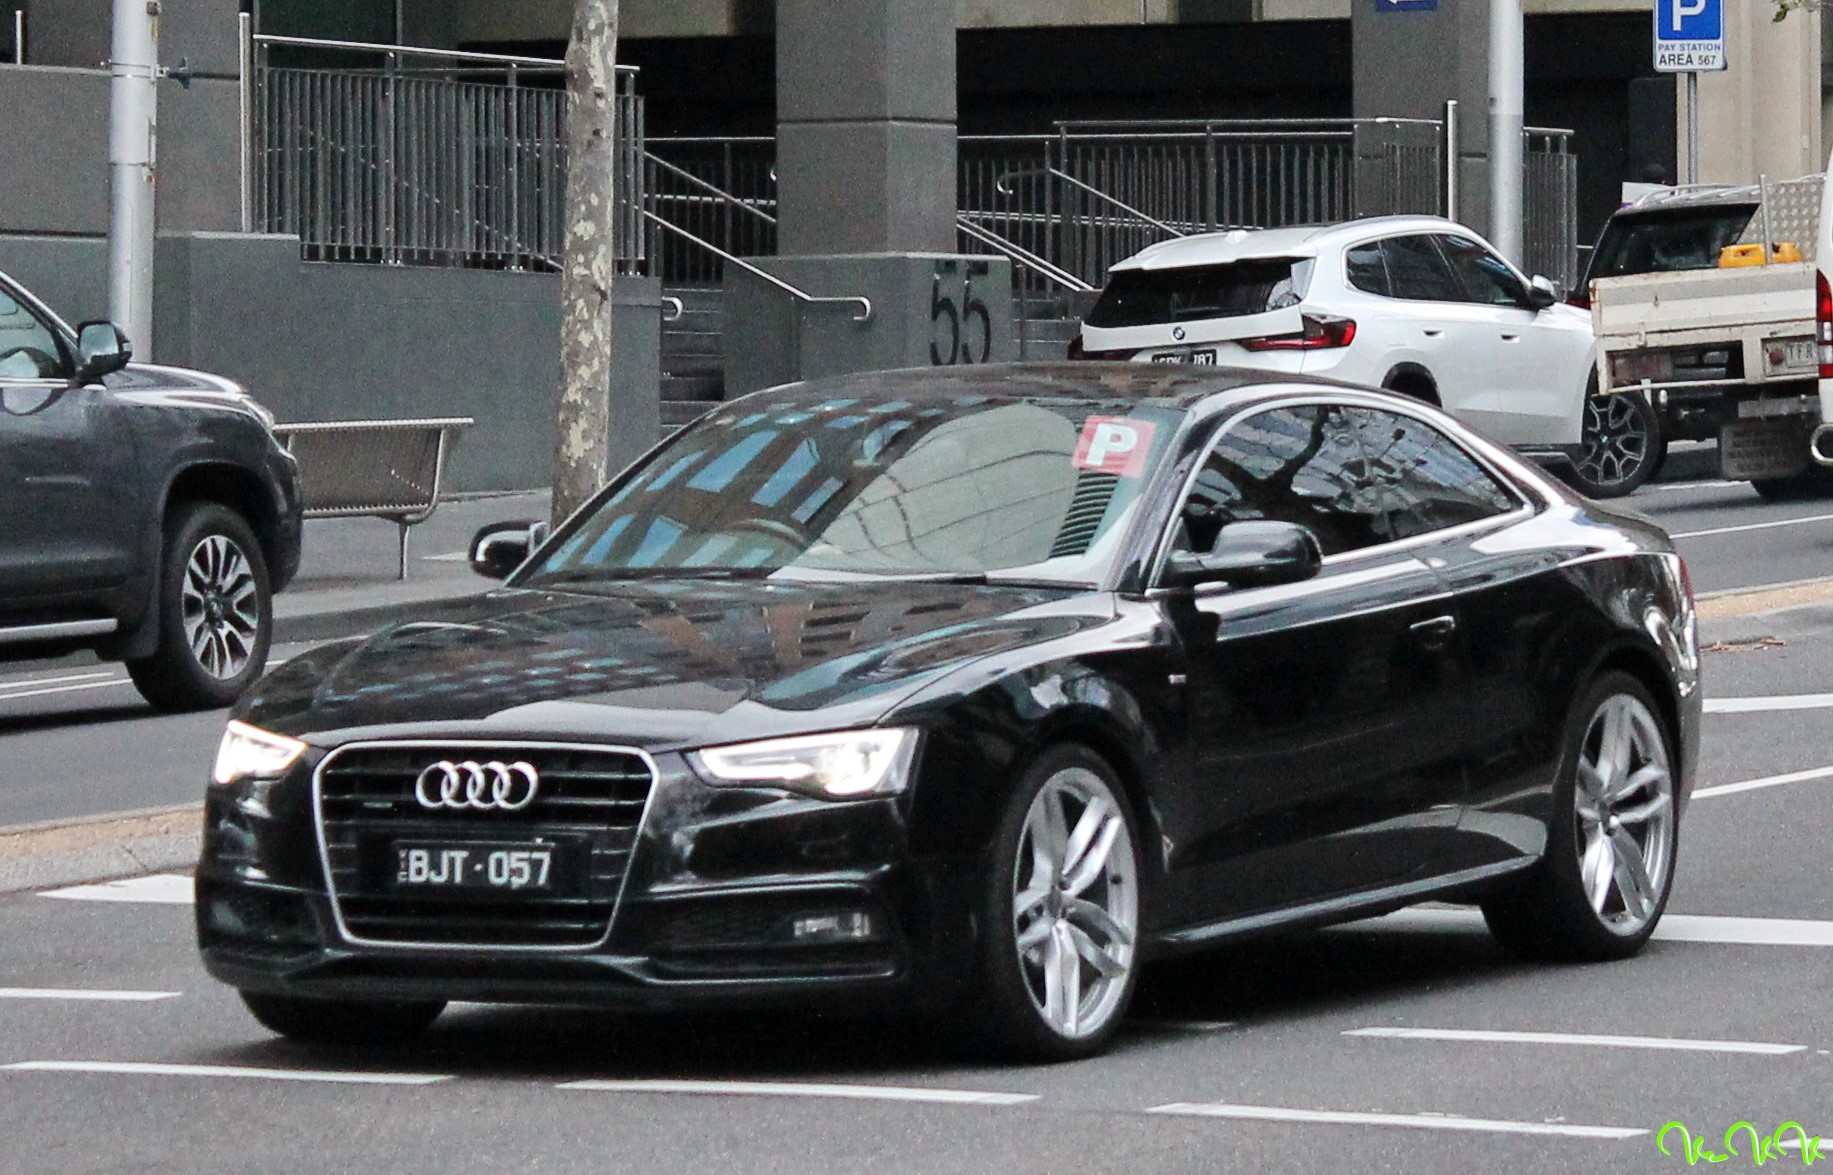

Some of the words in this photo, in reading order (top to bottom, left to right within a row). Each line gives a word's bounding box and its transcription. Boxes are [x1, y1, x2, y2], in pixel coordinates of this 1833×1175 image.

[1672, 0, 1708, 31] P
[1658, 43, 1675, 51] PAY
[1680, 43, 1720, 51] STATION
[1659, 53, 1693, 66] AREA
[1698, 55, 1716, 66] 567
[930, 260, 990, 366] 55
[1085, 423, 1138, 466] P
